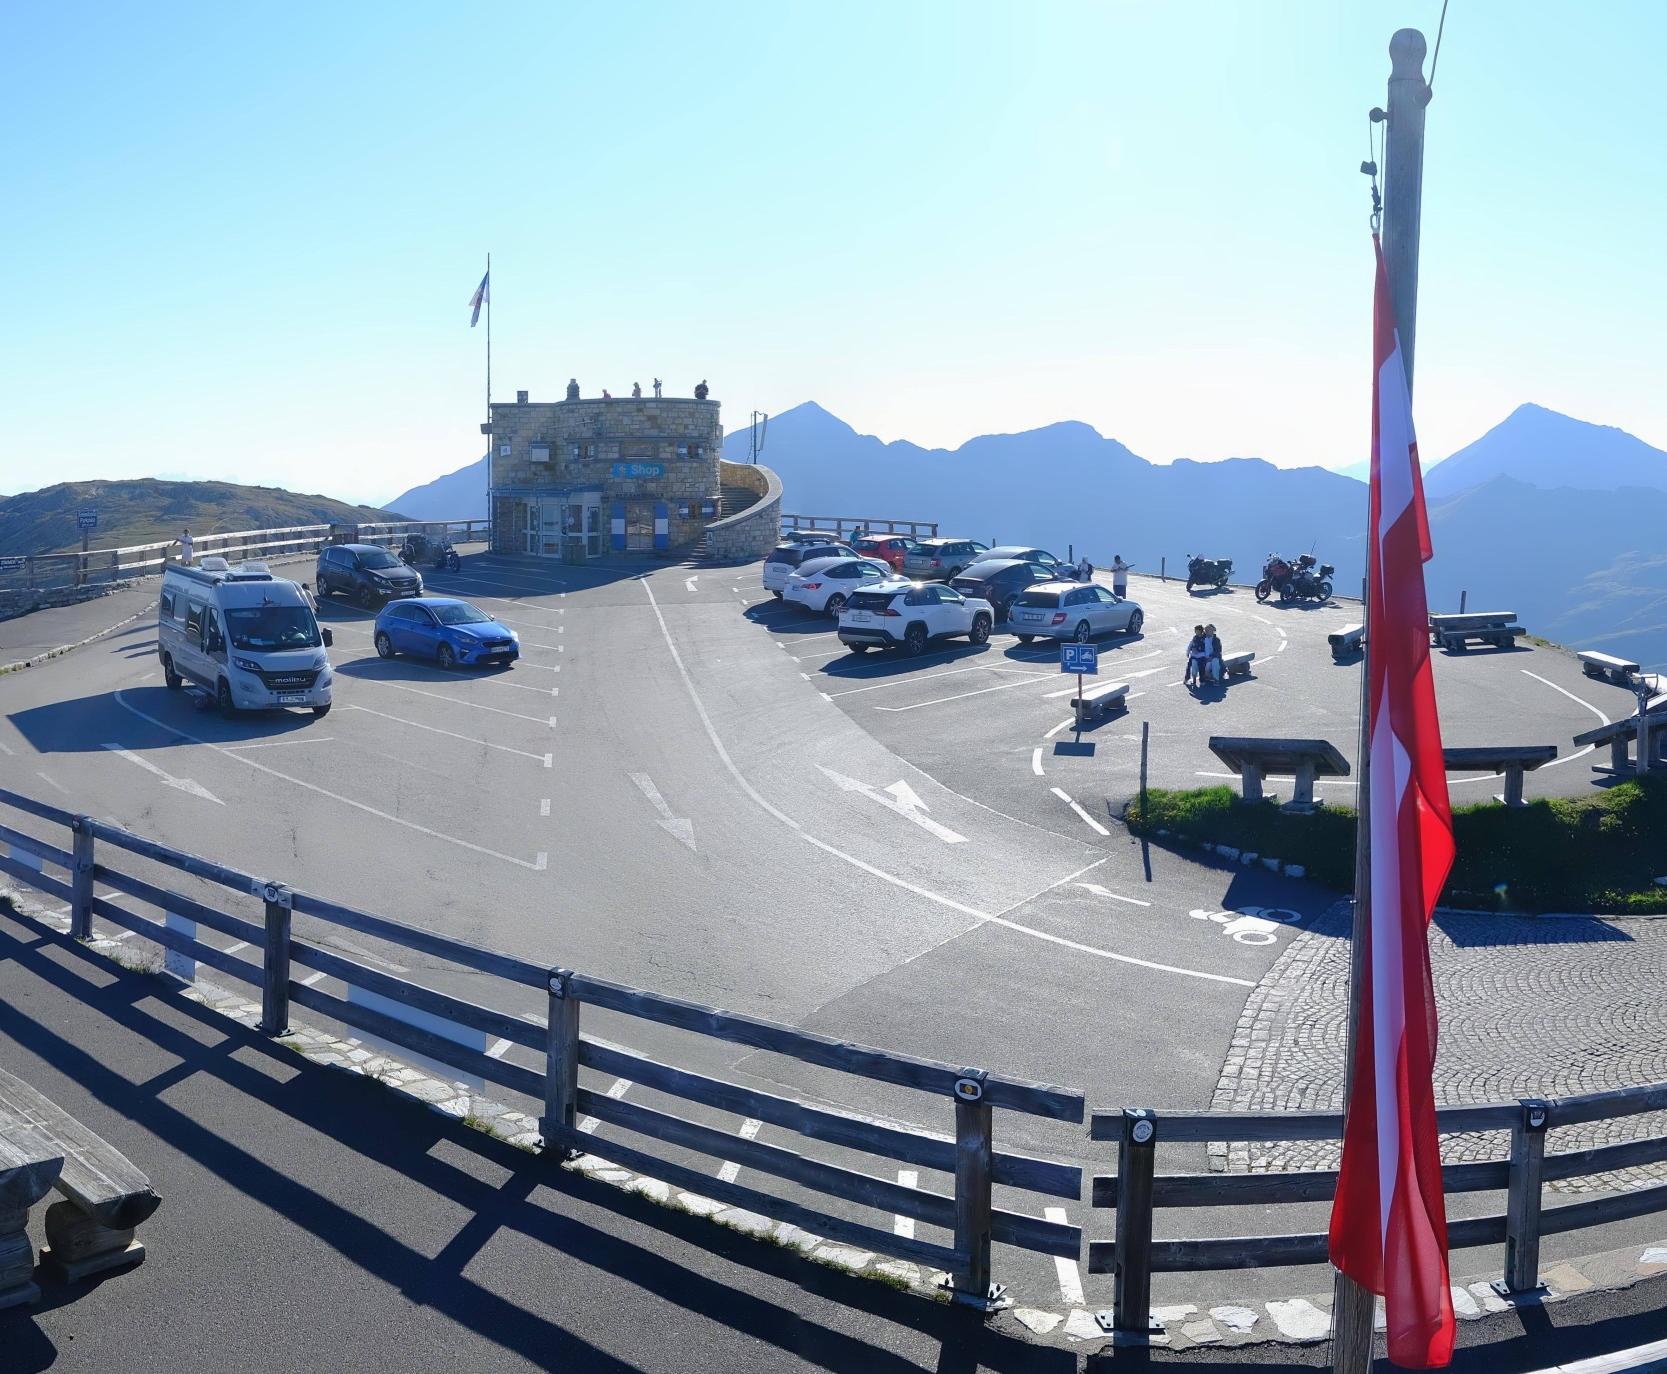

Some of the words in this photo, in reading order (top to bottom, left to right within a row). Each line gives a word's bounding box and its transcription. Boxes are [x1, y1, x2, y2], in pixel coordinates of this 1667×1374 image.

[632, 465, 660, 477] Shop
[1066, 649, 1075, 660] P
[275, 676, 306, 684] malibu
